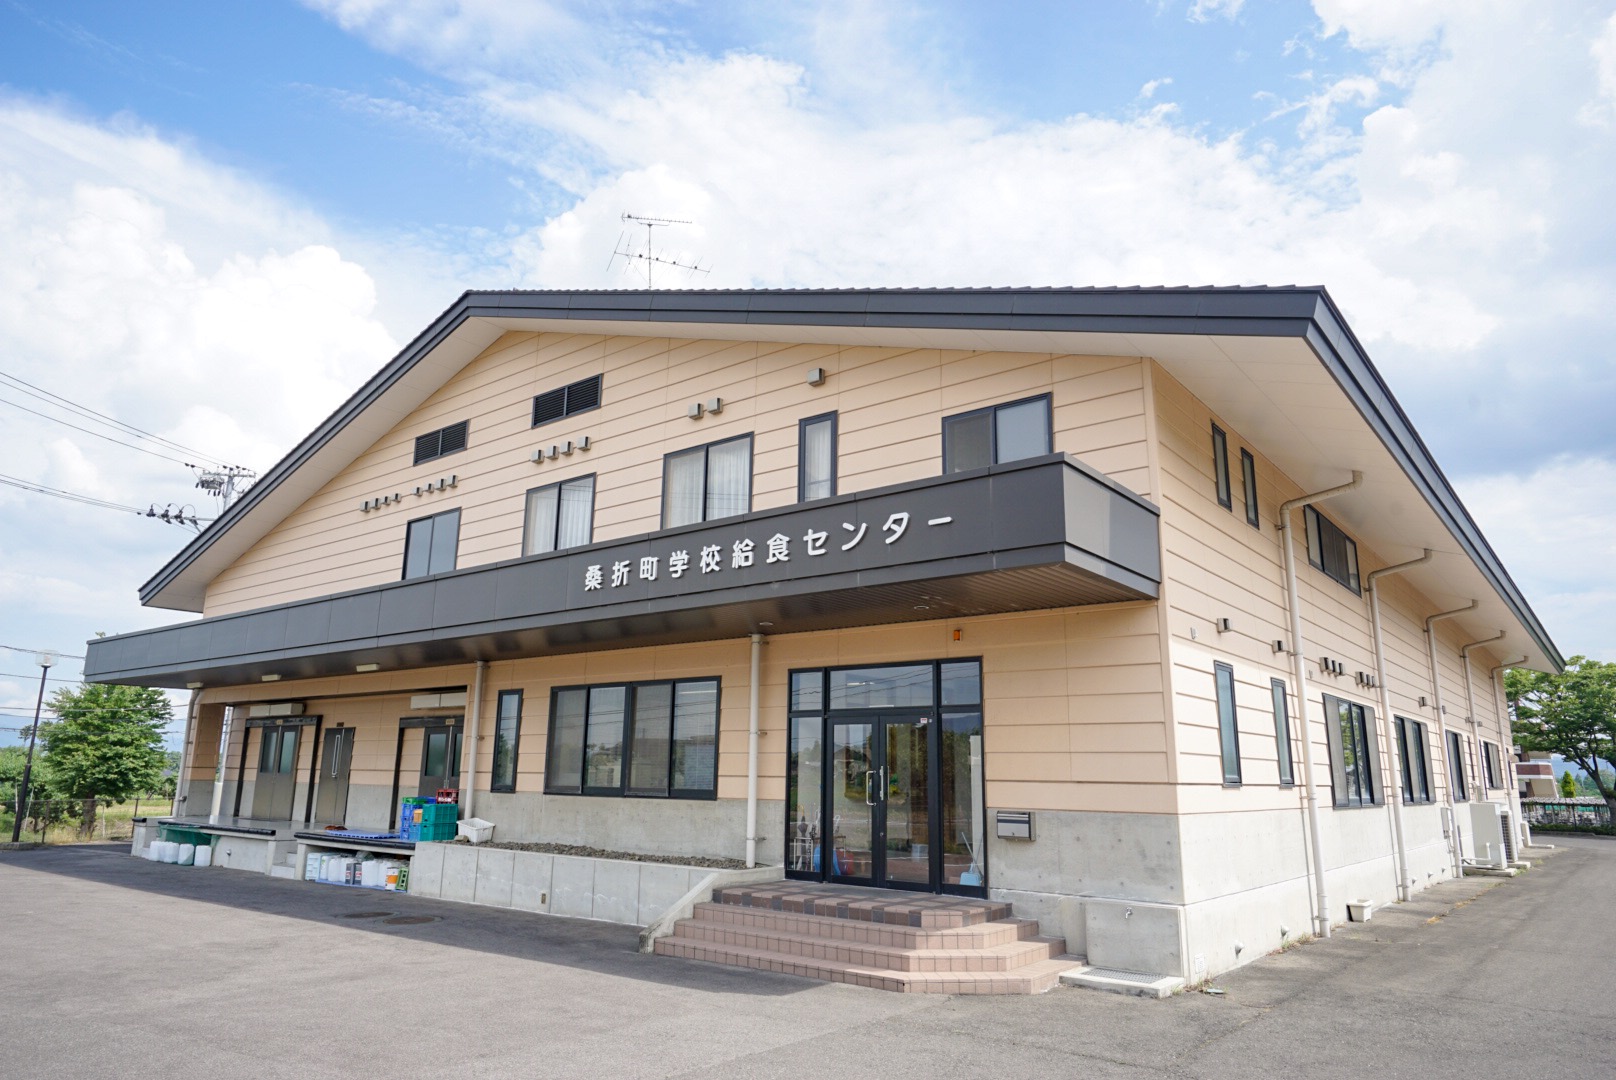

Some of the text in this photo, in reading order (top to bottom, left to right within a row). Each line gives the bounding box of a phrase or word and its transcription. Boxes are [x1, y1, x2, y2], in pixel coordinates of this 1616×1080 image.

[584, 512, 953, 591] 桑折町学校給食センター
